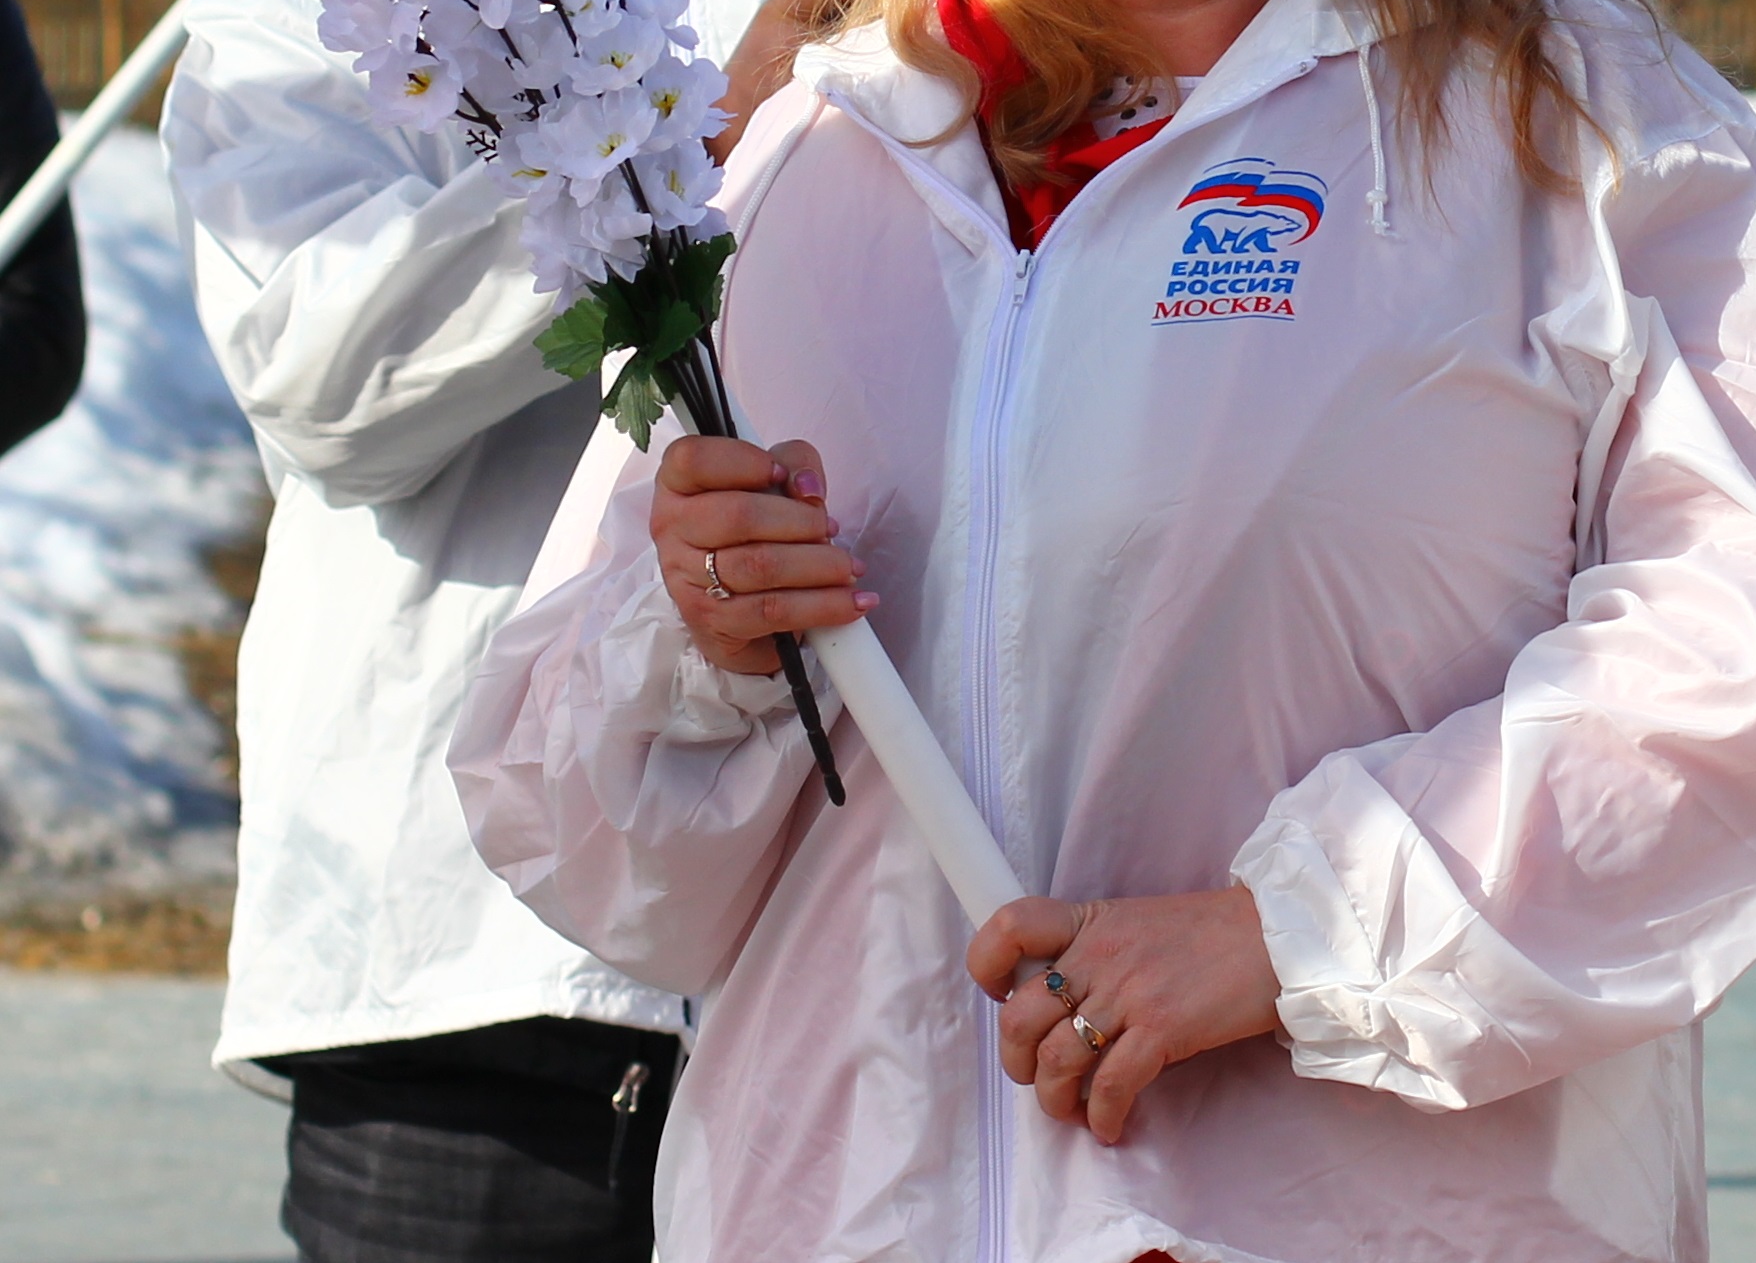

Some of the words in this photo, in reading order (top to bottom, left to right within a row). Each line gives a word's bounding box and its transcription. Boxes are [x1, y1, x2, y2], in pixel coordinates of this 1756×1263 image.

[1171, 259, 1300, 277] ЕДИНАЯ
[1166, 278, 1294, 297] РОССИЯ
[1152, 296, 1295, 319] МОСКВА
